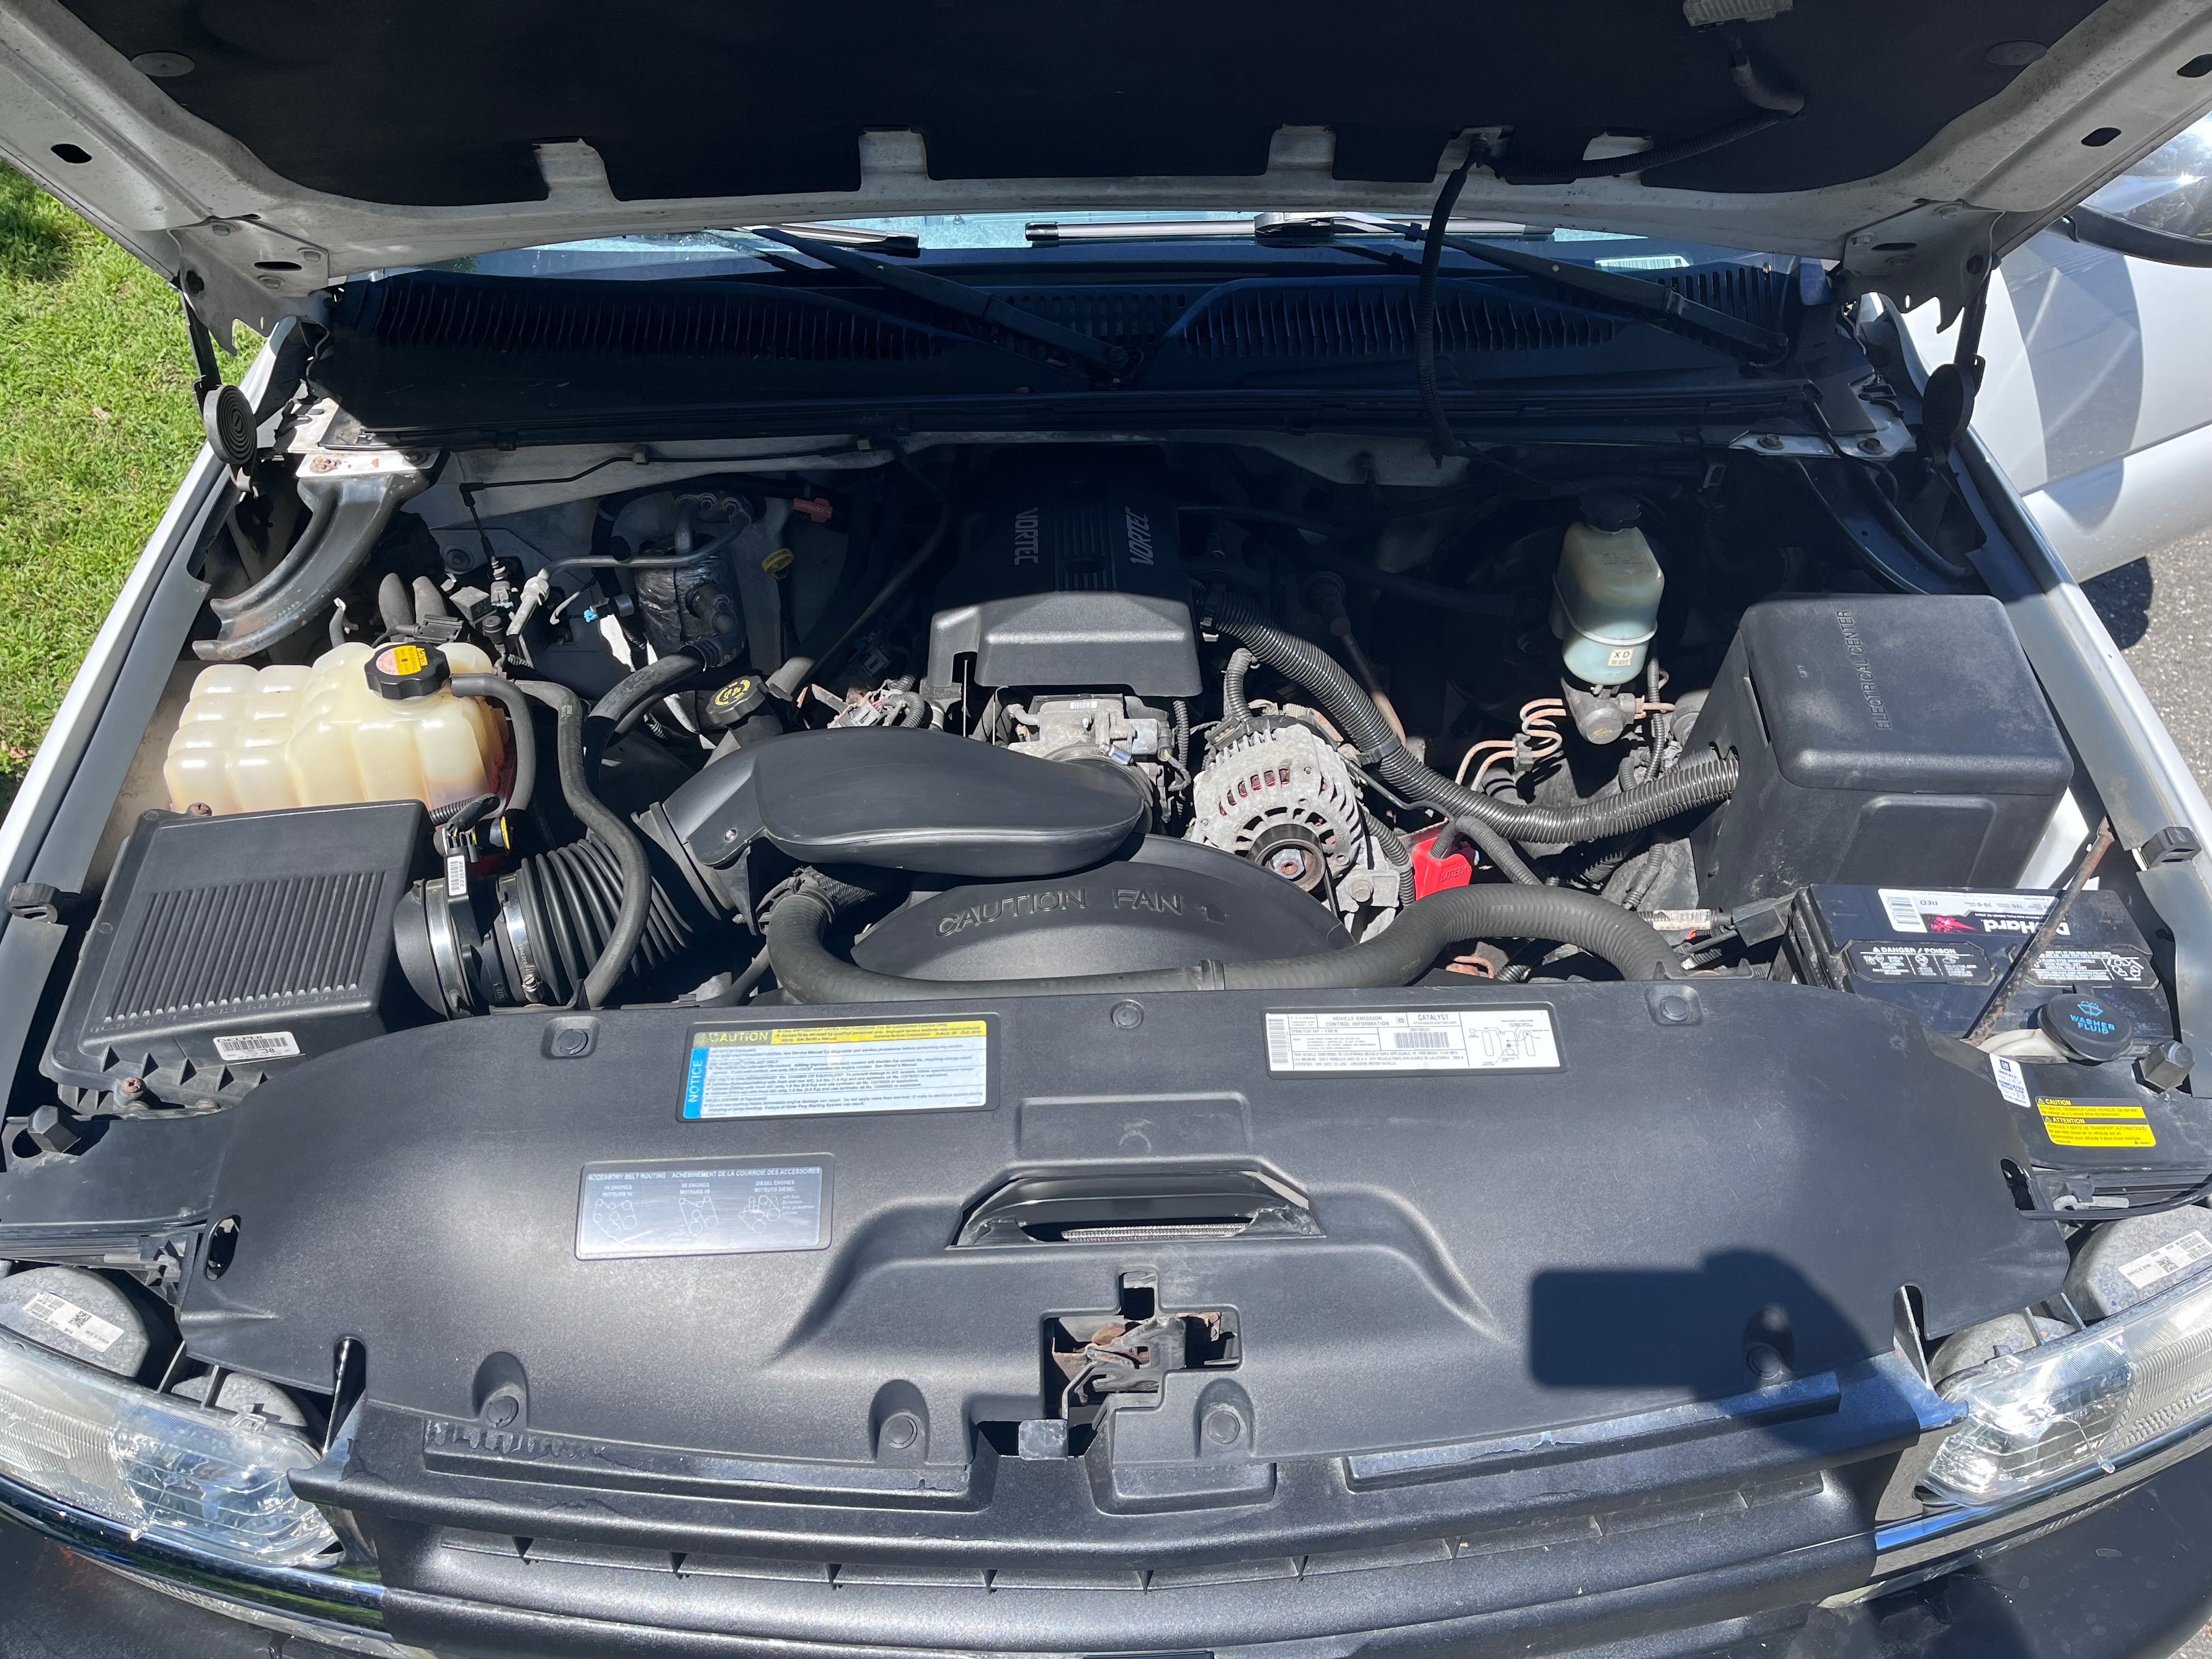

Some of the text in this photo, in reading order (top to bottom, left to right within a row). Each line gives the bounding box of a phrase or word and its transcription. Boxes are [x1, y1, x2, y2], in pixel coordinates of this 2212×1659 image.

[1014, 506, 1039, 566] VORTEC
[1124, 505, 1154, 566] VORTEC
[1836, 610, 1892, 730] ELECTRICAL CENTER
[935, 888, 1184, 938] CAUTION FAN
[709, 1031, 768, 1043] CAUTION
[2070, 1014, 2115, 1030] WASHER
[2078, 1022, 2109, 1034] FLUID
[687, 1059, 703, 1103] NOTICE
